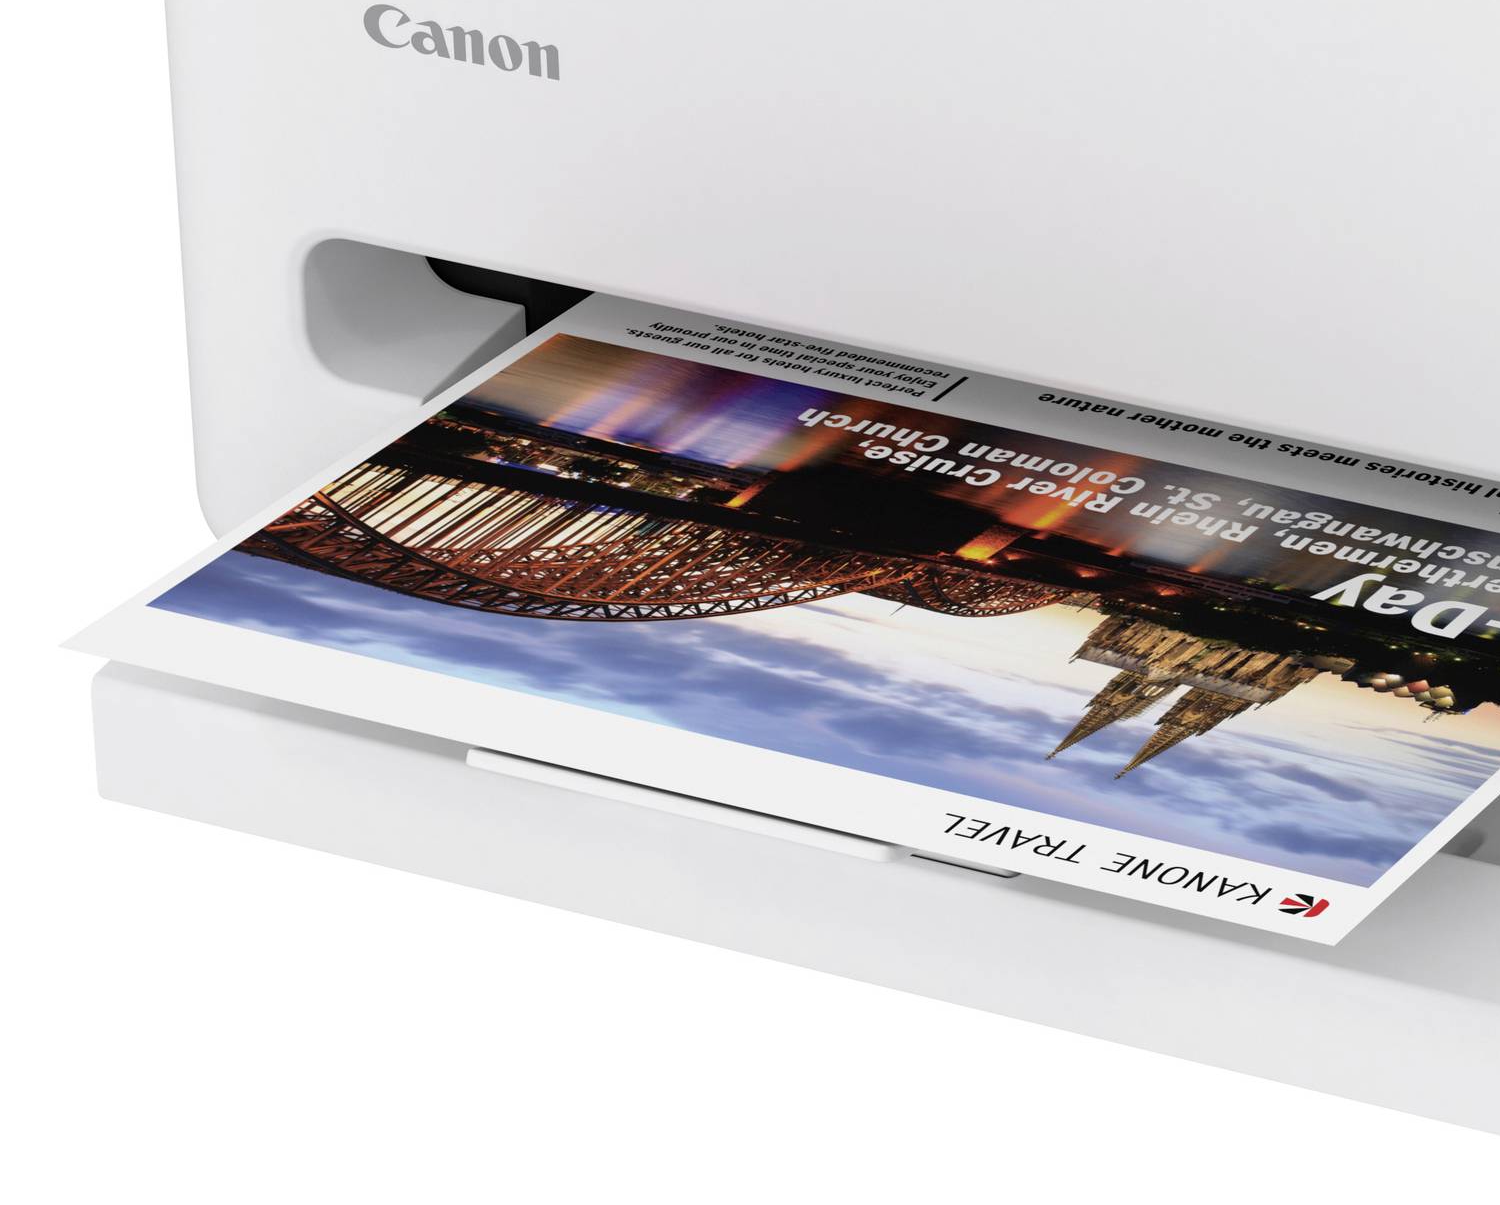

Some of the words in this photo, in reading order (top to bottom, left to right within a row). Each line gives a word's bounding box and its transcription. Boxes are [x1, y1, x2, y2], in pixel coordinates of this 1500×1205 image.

[363, 3, 560, 81] Canon
[625, 327, 682, 347] guests.
[649, 321, 710, 342] proudly
[709, 335, 737, 348] our
[713, 324, 764, 341] hotels.
[684, 341, 711, 355] our
[714, 348, 734, 359] all
[739, 342, 756, 351] in
[759, 344, 794, 359] time
[764, 336, 836, 356] five-star
[736, 351, 760, 364] for
[762, 357, 812, 373] hotels
[796, 352, 856, 372] special
[828, 350, 950, 378] recommended
[813, 367, 862, 385] luxury
[856, 363, 894, 378] your
[891, 371, 938, 388] Enjoy
[864, 379, 925, 397] Perfect
[1037, 392, 1126, 419] nature
[796, 406, 950, 453] Church
[1126, 411, 1224, 438] mother
[1227, 432, 1273, 452] the
[856, 439, 1002, 486] Cruise,
[1275, 443, 1360, 469] meets
[957, 441, 1146, 494] Coloman
[1363, 461, 1483, 494] histories
[1007, 476, 1122, 513] River
[1163, 485, 1221, 510] St.
[1129, 500, 1259, 544] Rhein
[943, 813, 1087, 864] TRAVEL
[1099, 852, 1272, 905] KANONE
